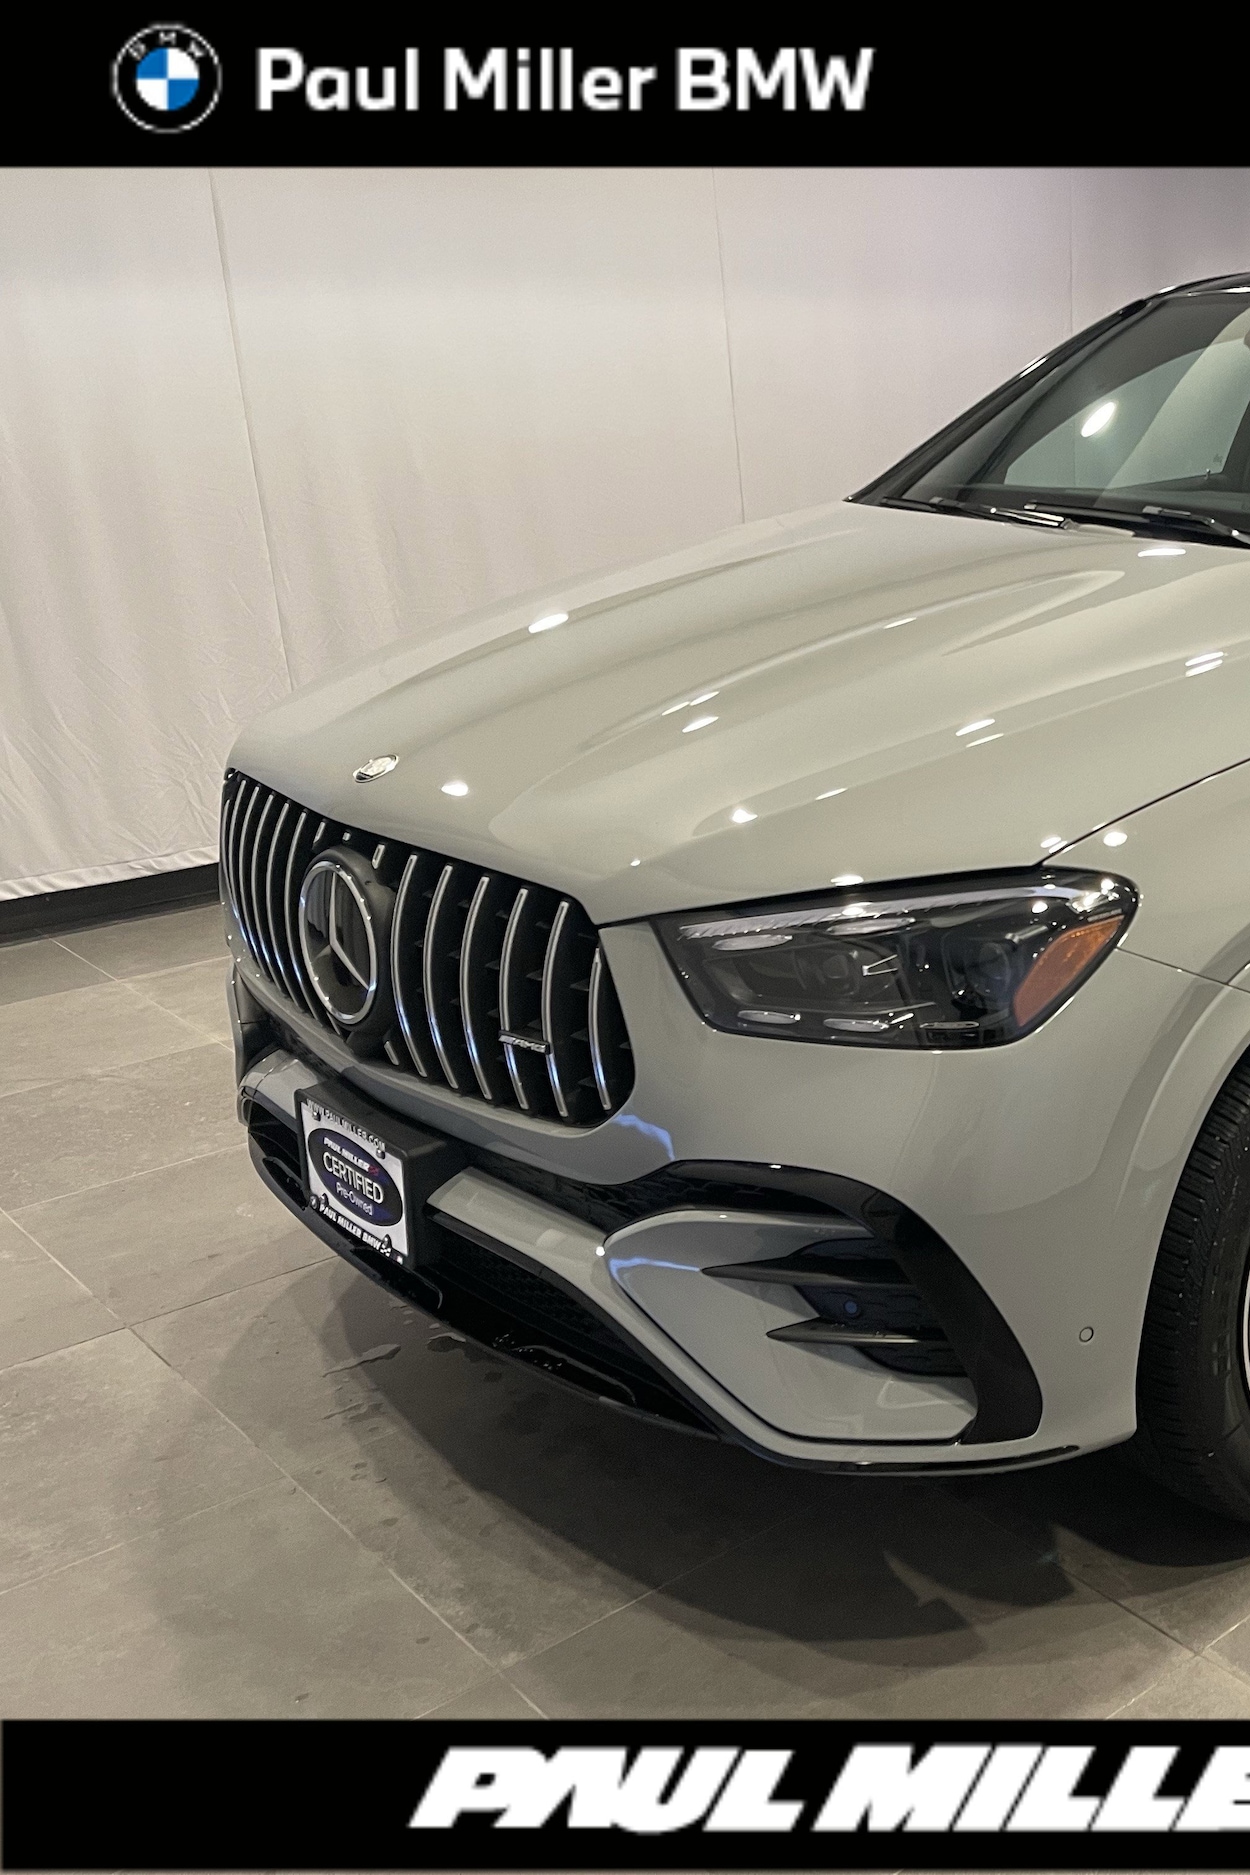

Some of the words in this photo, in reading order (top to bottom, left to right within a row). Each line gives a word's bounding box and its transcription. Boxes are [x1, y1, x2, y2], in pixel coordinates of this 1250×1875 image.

[323, 1136, 342, 1156] PAUL
[341, 1147, 371, 1173] MILLER
[322, 1151, 385, 1205] CERTIFIED
[335, 1181, 374, 1217] Pre-Owned
[319, 1203, 337, 1222] PAUL
[336, 1215, 362, 1239] MILLER
[361, 1231, 382, 1251] BMW
